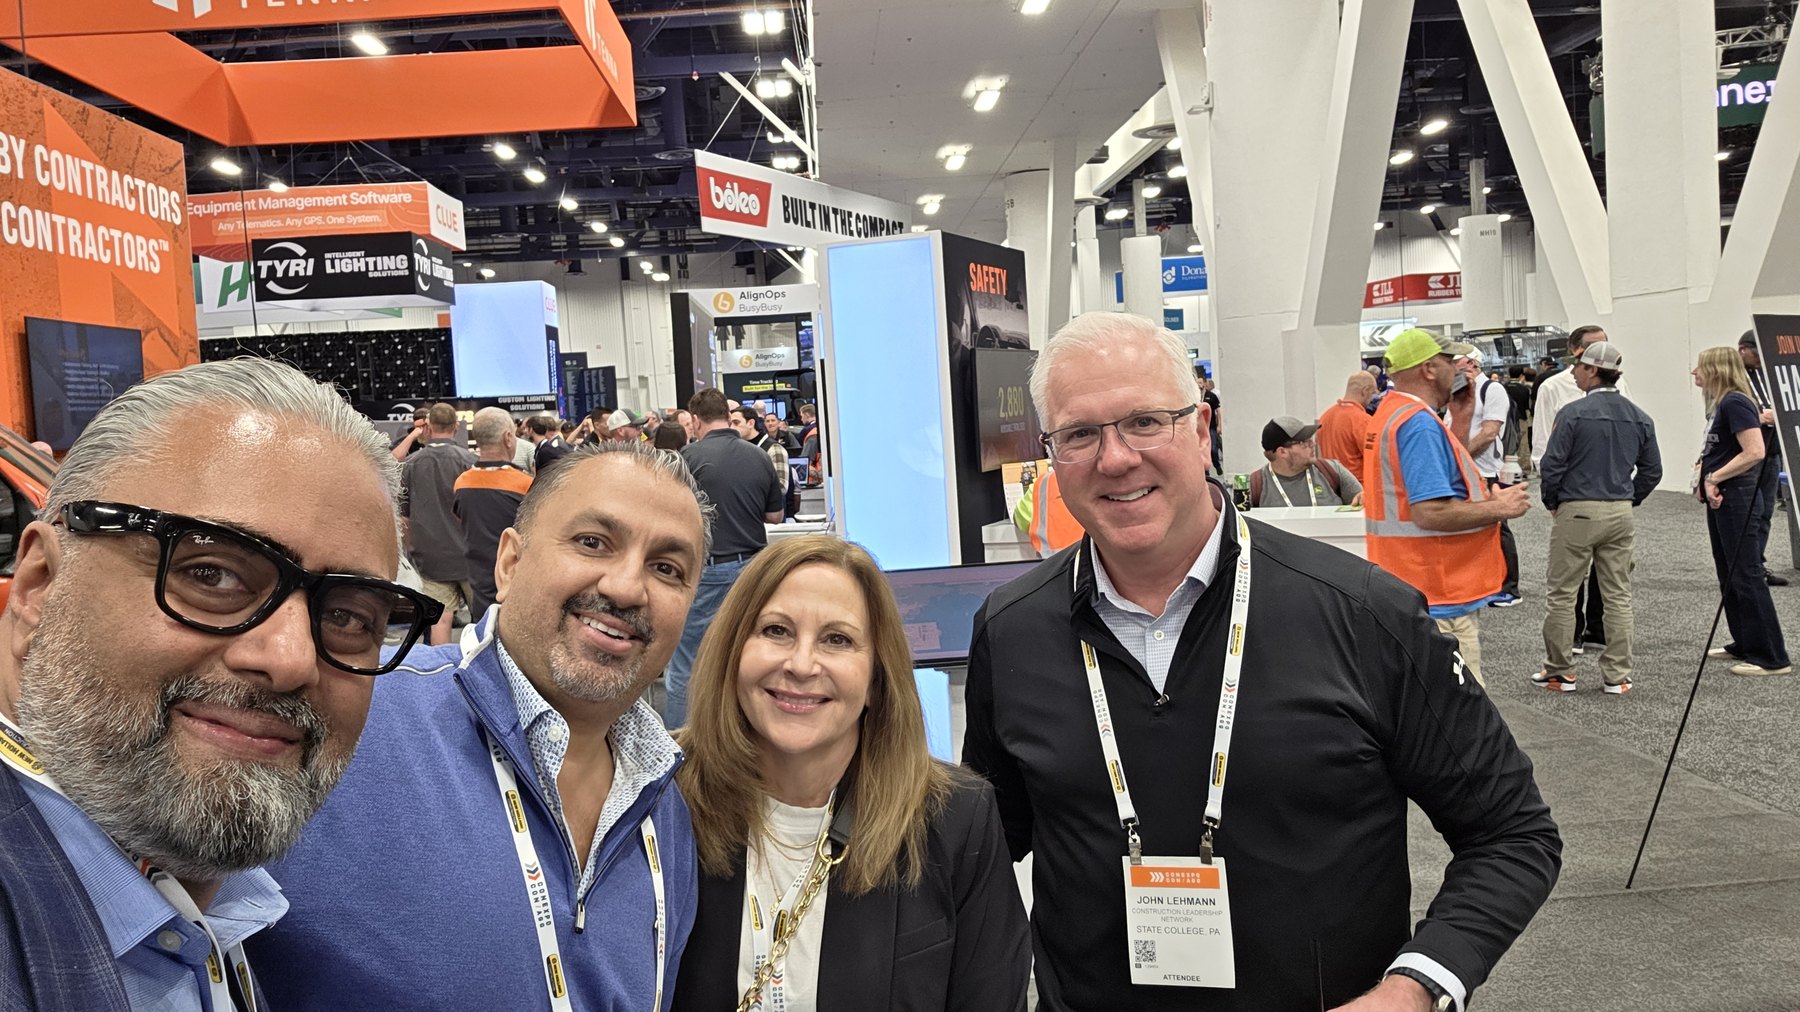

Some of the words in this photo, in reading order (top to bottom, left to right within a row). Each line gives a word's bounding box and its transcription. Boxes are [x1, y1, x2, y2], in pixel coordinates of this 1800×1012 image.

[0, 131, 26, 179] BY
[34, 144, 182, 225] CONTRACTORS
[188, 200, 256, 216] Equipment
[259, 194, 348, 212] Management
[350, 191, 412, 204] Software
[218, 222, 235, 232] Any
[286, 218, 302, 228] Any
[304, 216, 324, 226] GPS.
[326, 215, 344, 224] One
[346, 214, 382, 224] System.
[436, 204, 458, 232] CLUE
[782, 195, 817, 229] BUILT
[818, 204, 831, 232] IN
[832, 207, 854, 237] THE
[324, 250, 366, 259] INTELLIGENT
[257, 258, 314, 278] TYRI
[325, 254, 408, 274] LIGHTING
[414, 252, 431, 276] TYRI
[368, 270, 409, 278] SOLUTIONS
[969, 262, 1008, 296] SAFETY
[739, 290, 786, 302] AlignOps
[739, 303, 783, 313] BusyBusy
[1776, 336, 1794, 354] JOIN
[755, 352, 785, 361] AlignOps
[498, 396, 526, 404] CUSTOM
[526, 395, 556, 403] LIGHTING
[510, 404, 546, 412] SOLUTIONS
[998, 386, 1024, 420] 2,880
[387, 411, 414, 422] TYR
[0, 737, 19, 754] HOLLA
[18, 752, 33, 764] NEW
[531, 883, 545, 928] CON/AGG
[538, 881, 552, 926] CONEXPO
[1137, 896, 1164, 905] JOHN
[1167, 897, 1216, 906] LEHMANN
[1136, 926, 1162, 934] STATE
[1164, 926, 1207, 936] COLLEGE,
[1210, 928, 1221, 936] PA
